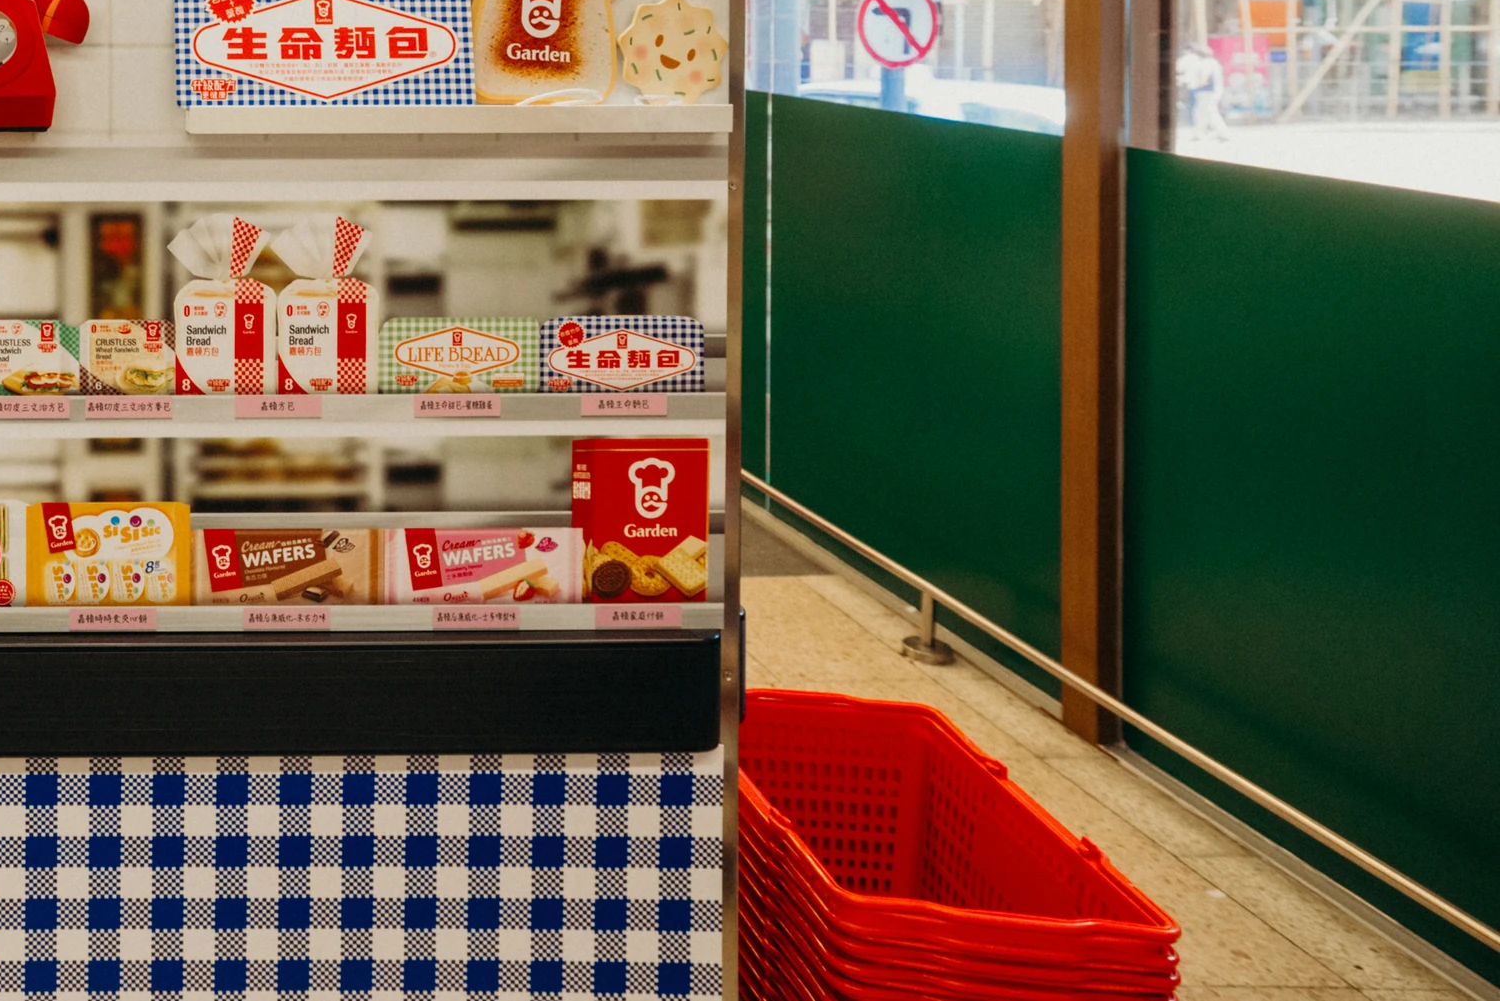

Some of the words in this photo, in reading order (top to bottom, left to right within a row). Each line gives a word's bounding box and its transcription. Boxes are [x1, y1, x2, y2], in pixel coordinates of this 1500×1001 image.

[222, 26, 429, 60] 生命麵包
[506, 41, 571, 64] Garden
[186, 325, 227, 335] Sandwich
[289, 324, 330, 335] Sandwich
[95, 338, 137, 346] CRUSTLESS
[186, 336, 212, 346] Bread
[289, 336, 314, 346] Bread
[407, 347, 444, 362] LIFE
[449, 346, 511, 365] BREAD
[566, 349, 680, 369] 生命麵包
[95, 381, 102, 391] 6
[182, 379, 191, 391] 8
[284, 378, 294, 391] 8
[623, 523, 678, 538] Garden
[50, 539, 74, 549] Garden
[241, 540, 281, 553] Cream
[442, 539, 481, 551] Cream
[241, 543, 316, 568] WAFERS
[442, 542, 516, 567] WAFERS
[145, 561, 154, 574] 8
[414, 569, 437, 577] Garden
[213, 571, 237, 579] Garden
